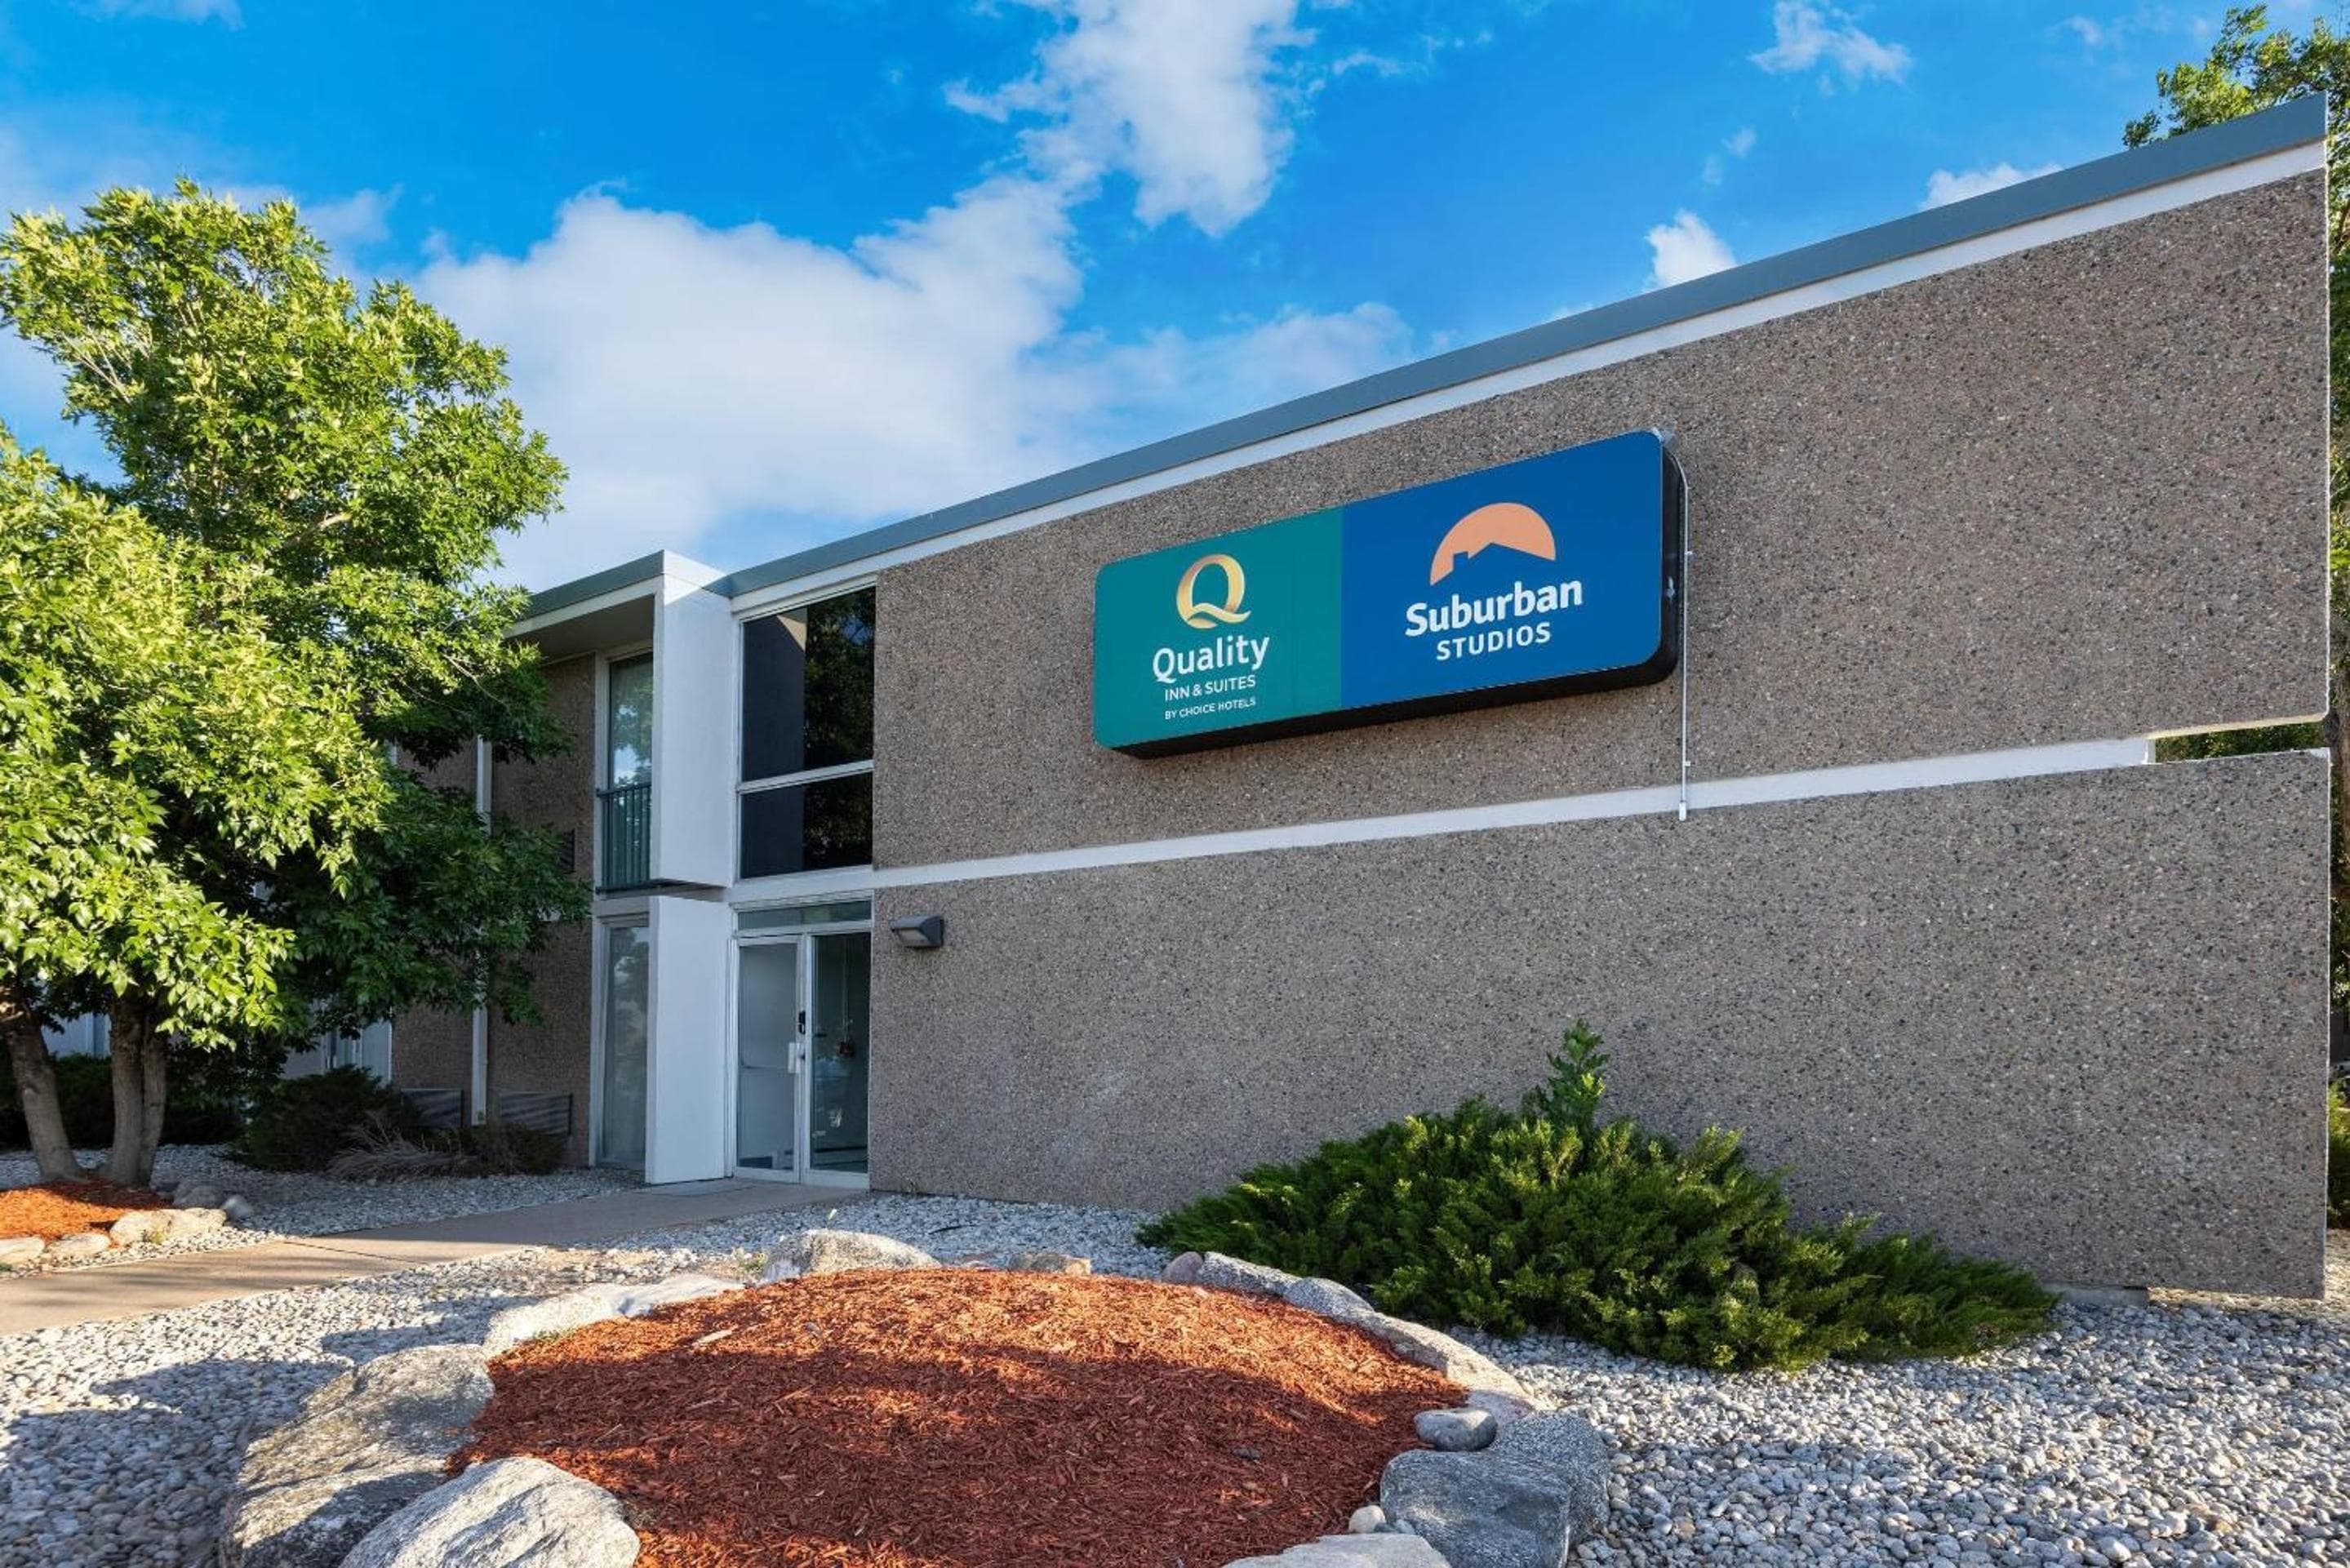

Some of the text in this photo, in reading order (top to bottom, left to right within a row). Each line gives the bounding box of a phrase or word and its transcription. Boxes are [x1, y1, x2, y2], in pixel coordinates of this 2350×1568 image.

[1176, 553, 1251, 629] Q
[1405, 580, 1583, 637] Suburban
[1152, 634, 1270, 684] Quality
[1436, 622, 1551, 661] STUDIOS
[1165, 674, 1256, 701] INN & SUITES
[1165, 697, 1256, 720] BY CHOICE HOTELS
